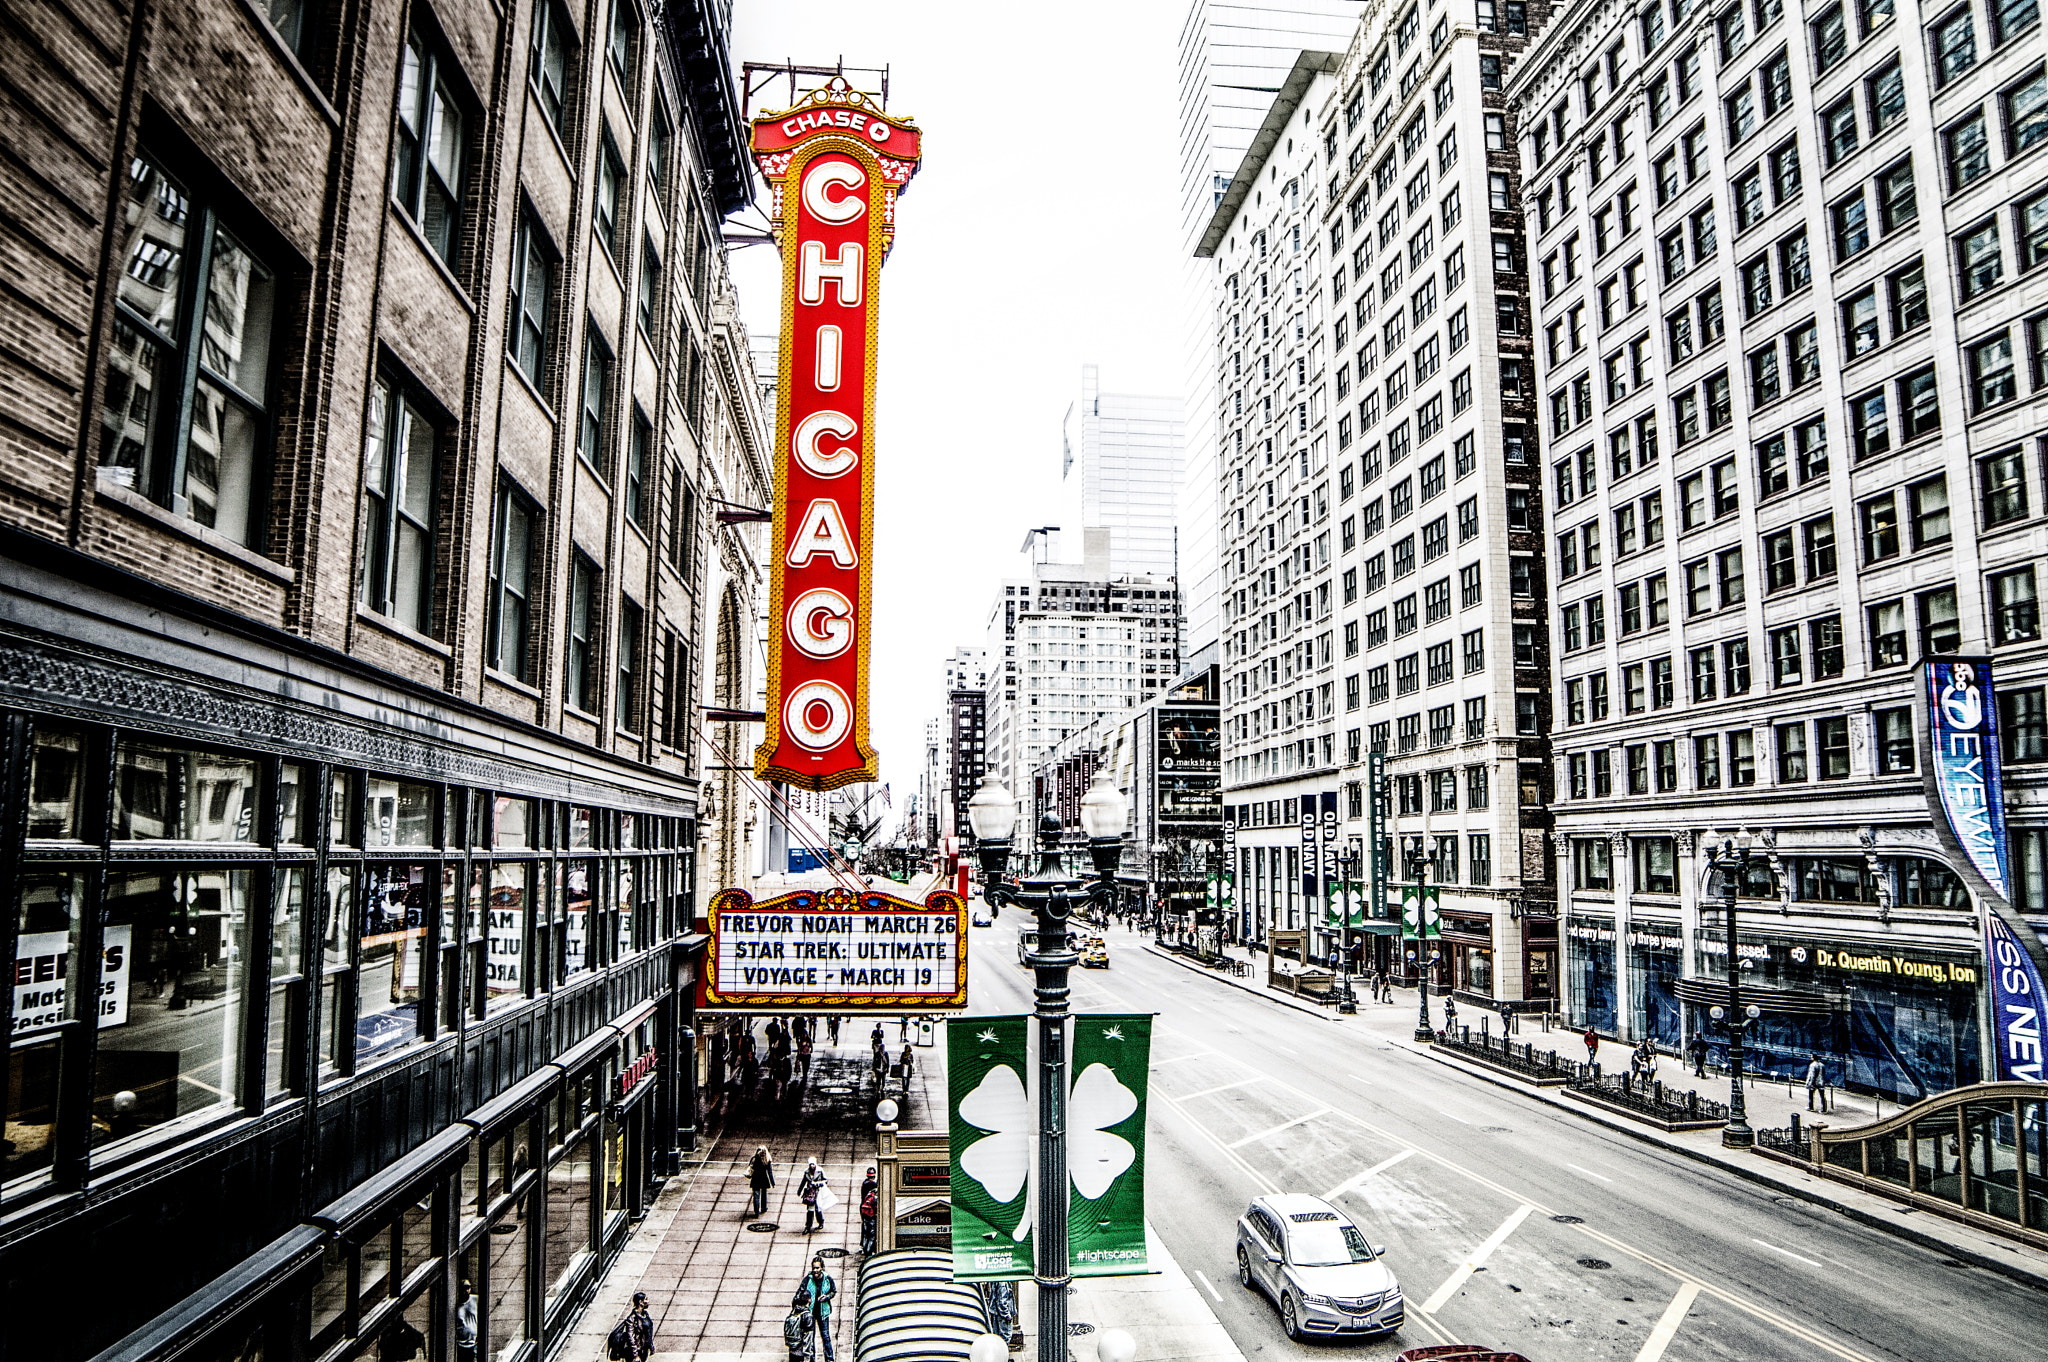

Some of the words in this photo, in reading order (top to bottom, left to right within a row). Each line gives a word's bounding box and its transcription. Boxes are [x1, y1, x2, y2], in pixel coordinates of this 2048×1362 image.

[782, 110, 868, 138] CHASE
[782, 160, 866, 753] CHICAGO
[1373, 757, 1382, 792] GENE
[1224, 820, 1235, 842] OLD
[1302, 813, 1315, 840] OLD
[1324, 811, 1336, 839] OLD
[1375, 797, 1383, 851] SISKEL
[1225, 843, 1236, 873] NAVY
[1303, 841, 1316, 877] NAVY
[1323, 841, 1336, 878] NAVY
[721, 914, 794, 933] TREVOR
[801, 914, 853, 933] NOAH
[864, 914, 929, 933] MARCH
[934, 914, 956, 933] 26
[735, 940, 785, 960] STAR
[793, 940, 847, 960] TREK:
[857, 940, 947, 960] ULTIMATE
[1579, 926, 1598, 942] carry
[1598, 927, 1612, 941] law
[1637, 931, 1660, 947] three
[1707, 941, 1728, 954] was
[1736, 944, 1771, 959] assed.
[743, 966, 818, 985] VOYAGE
[839, 966, 906, 985] MARCH
[914, 966, 932, 985] 19
[1817, 949, 1837, 967] Dr.
[1838, 952, 1892, 974] Quentin
[1892, 956, 1948, 983] Young,
[908, 1215, 932, 1224] Lake
[1076, 1249, 1140, 1264] #lightscape
